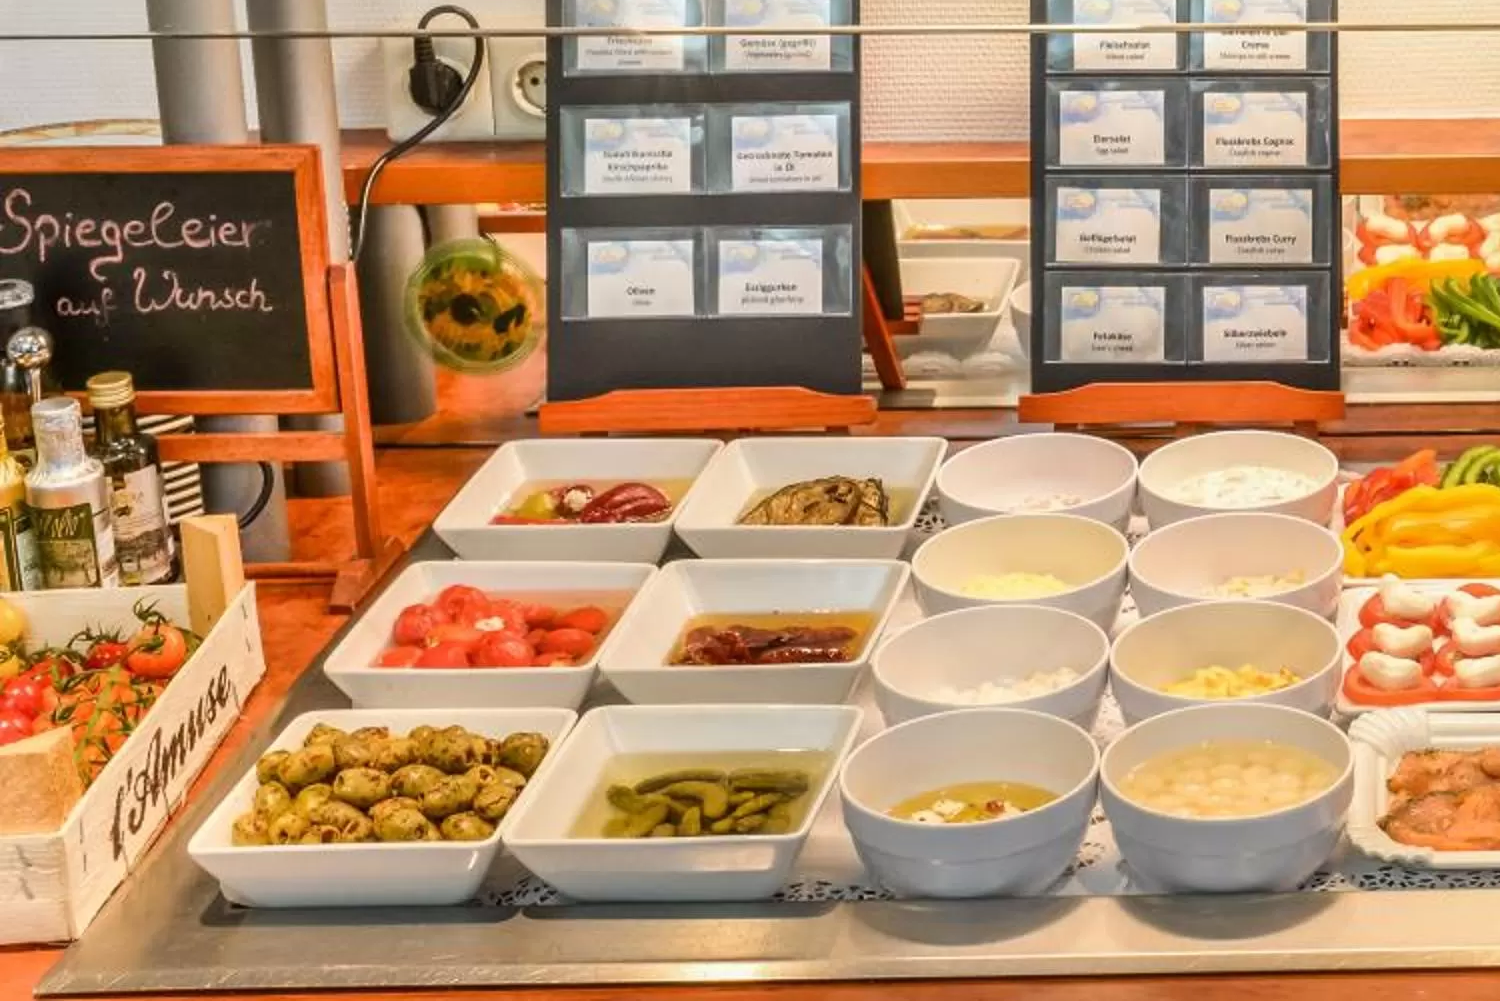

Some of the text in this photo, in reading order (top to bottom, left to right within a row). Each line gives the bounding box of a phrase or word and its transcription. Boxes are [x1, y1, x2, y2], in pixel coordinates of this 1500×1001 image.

[0, 188, 268, 282] Spiegeleier
[57, 267, 272, 325] auf Wunsch
